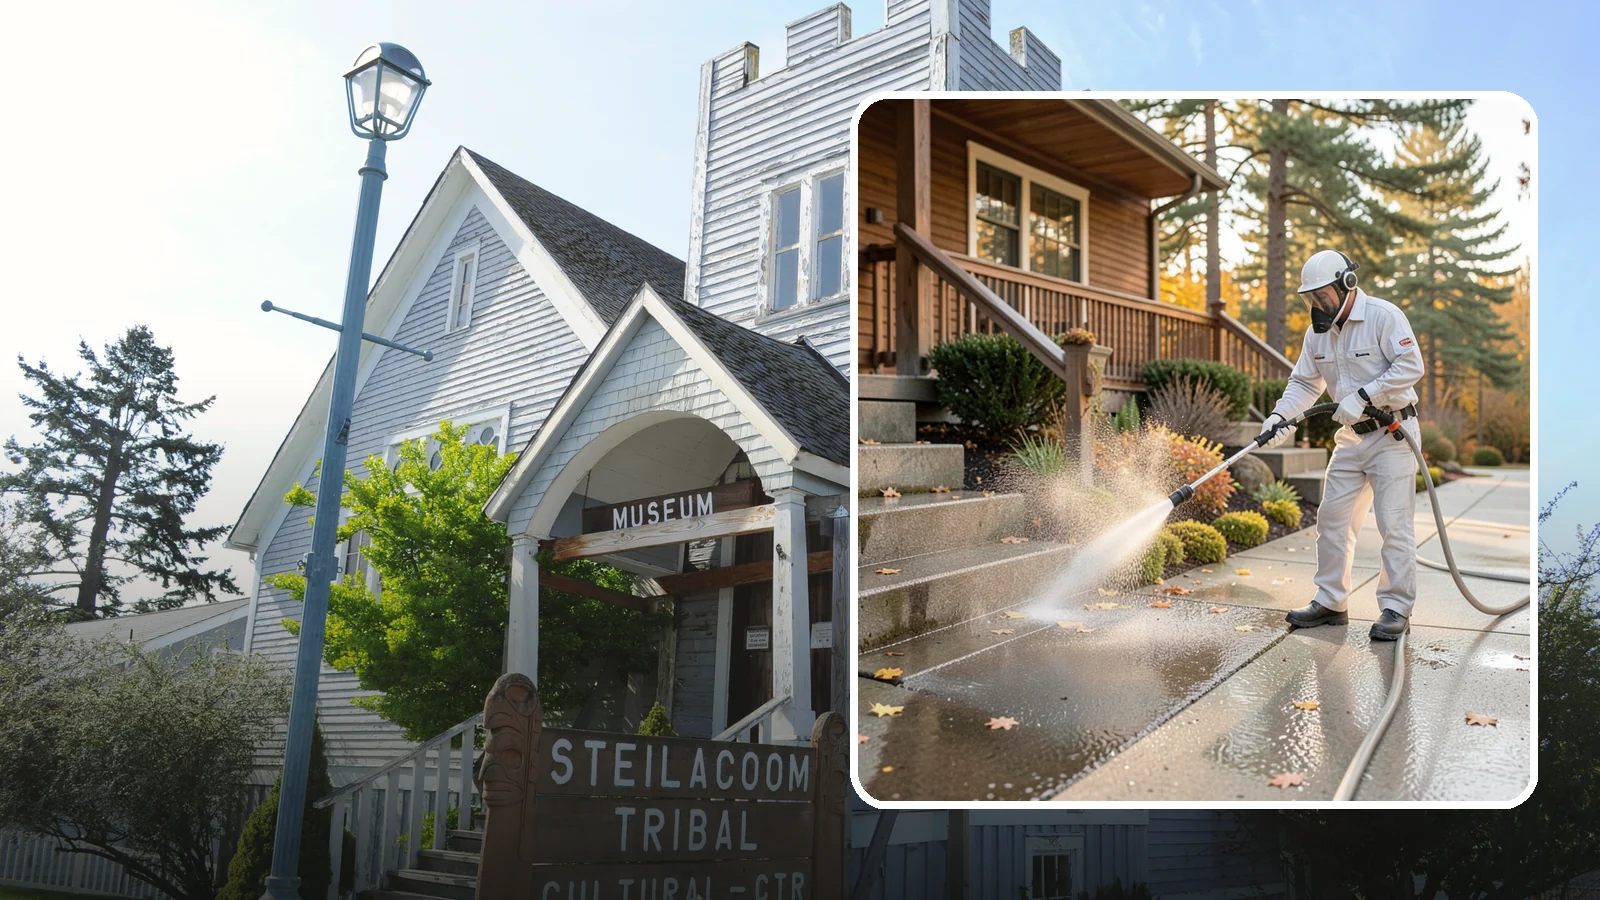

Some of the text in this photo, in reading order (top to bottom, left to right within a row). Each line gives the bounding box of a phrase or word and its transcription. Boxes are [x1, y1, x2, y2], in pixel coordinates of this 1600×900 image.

[613, 491, 713, 531] MUSEUM
[550, 738, 809, 792] STEILACOOM
[615, 807, 757, 851] TRIBAL
